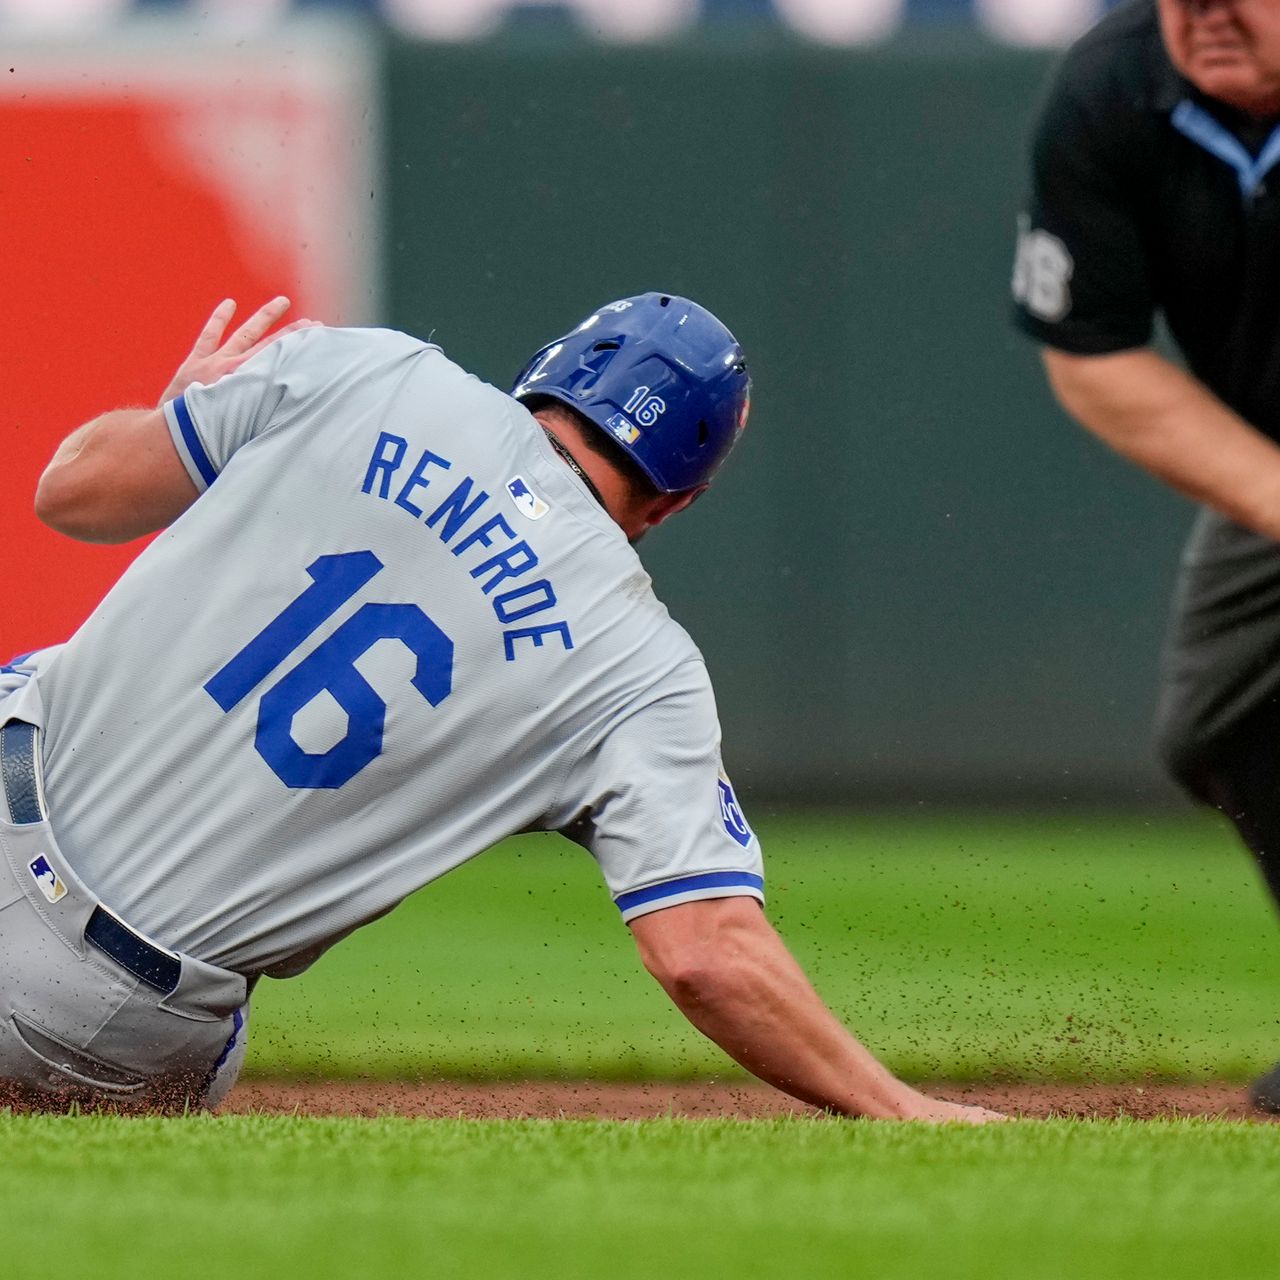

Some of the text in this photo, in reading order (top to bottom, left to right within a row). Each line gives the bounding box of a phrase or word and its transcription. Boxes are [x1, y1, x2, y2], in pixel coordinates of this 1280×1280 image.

[622, 385, 666, 426] 16
[361, 431, 574, 661] RENFROE
[203, 550, 455, 789] 16
